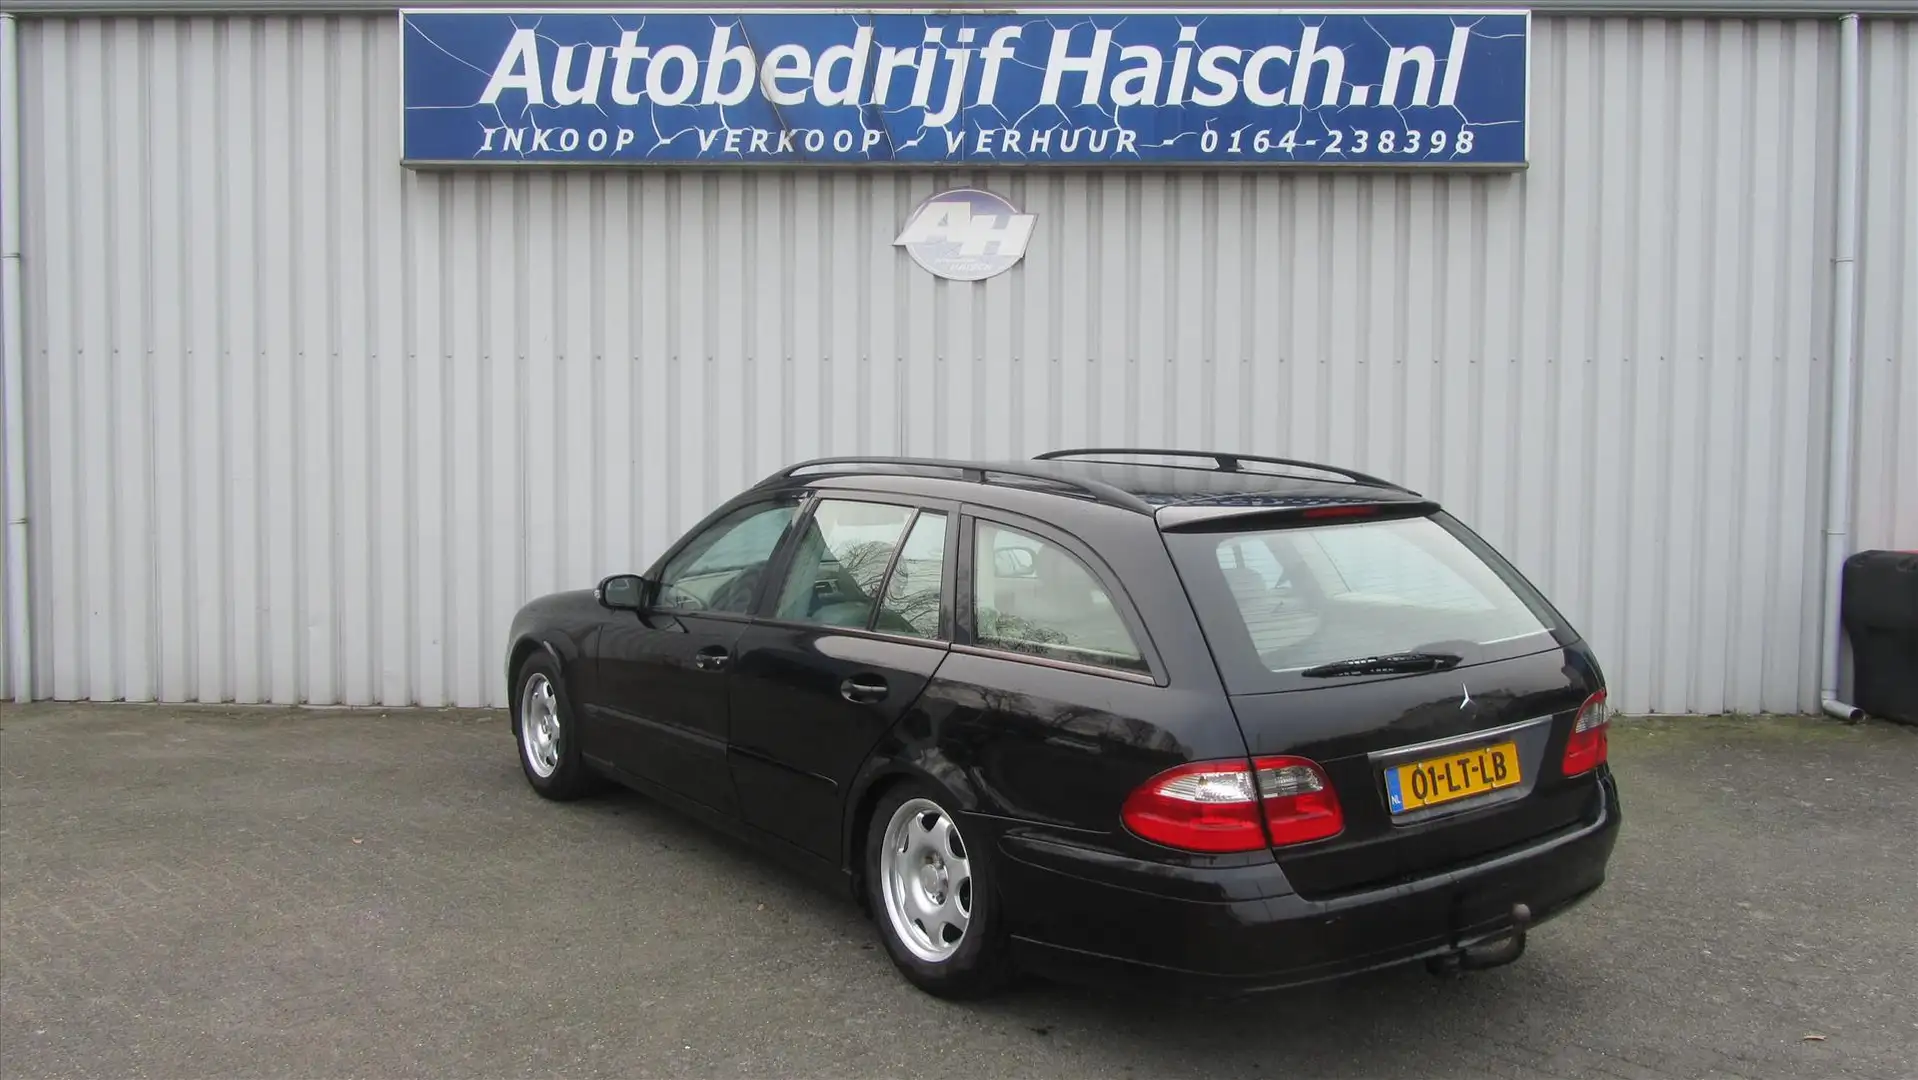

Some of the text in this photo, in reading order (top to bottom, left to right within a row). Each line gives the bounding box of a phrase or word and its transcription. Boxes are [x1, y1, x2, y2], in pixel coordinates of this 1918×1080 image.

[478, 26, 1470, 128] Autobedrijf Haisch.nl
[480, 128, 634, 151] INKOOP
[699, 129, 880, 152] VERKOOP
[946, 129, 1137, 152] VERHUUR
[1201, 130, 1474, 153] 0164-238398
[1411, 751, 1507, 800] 01-LT-LB
